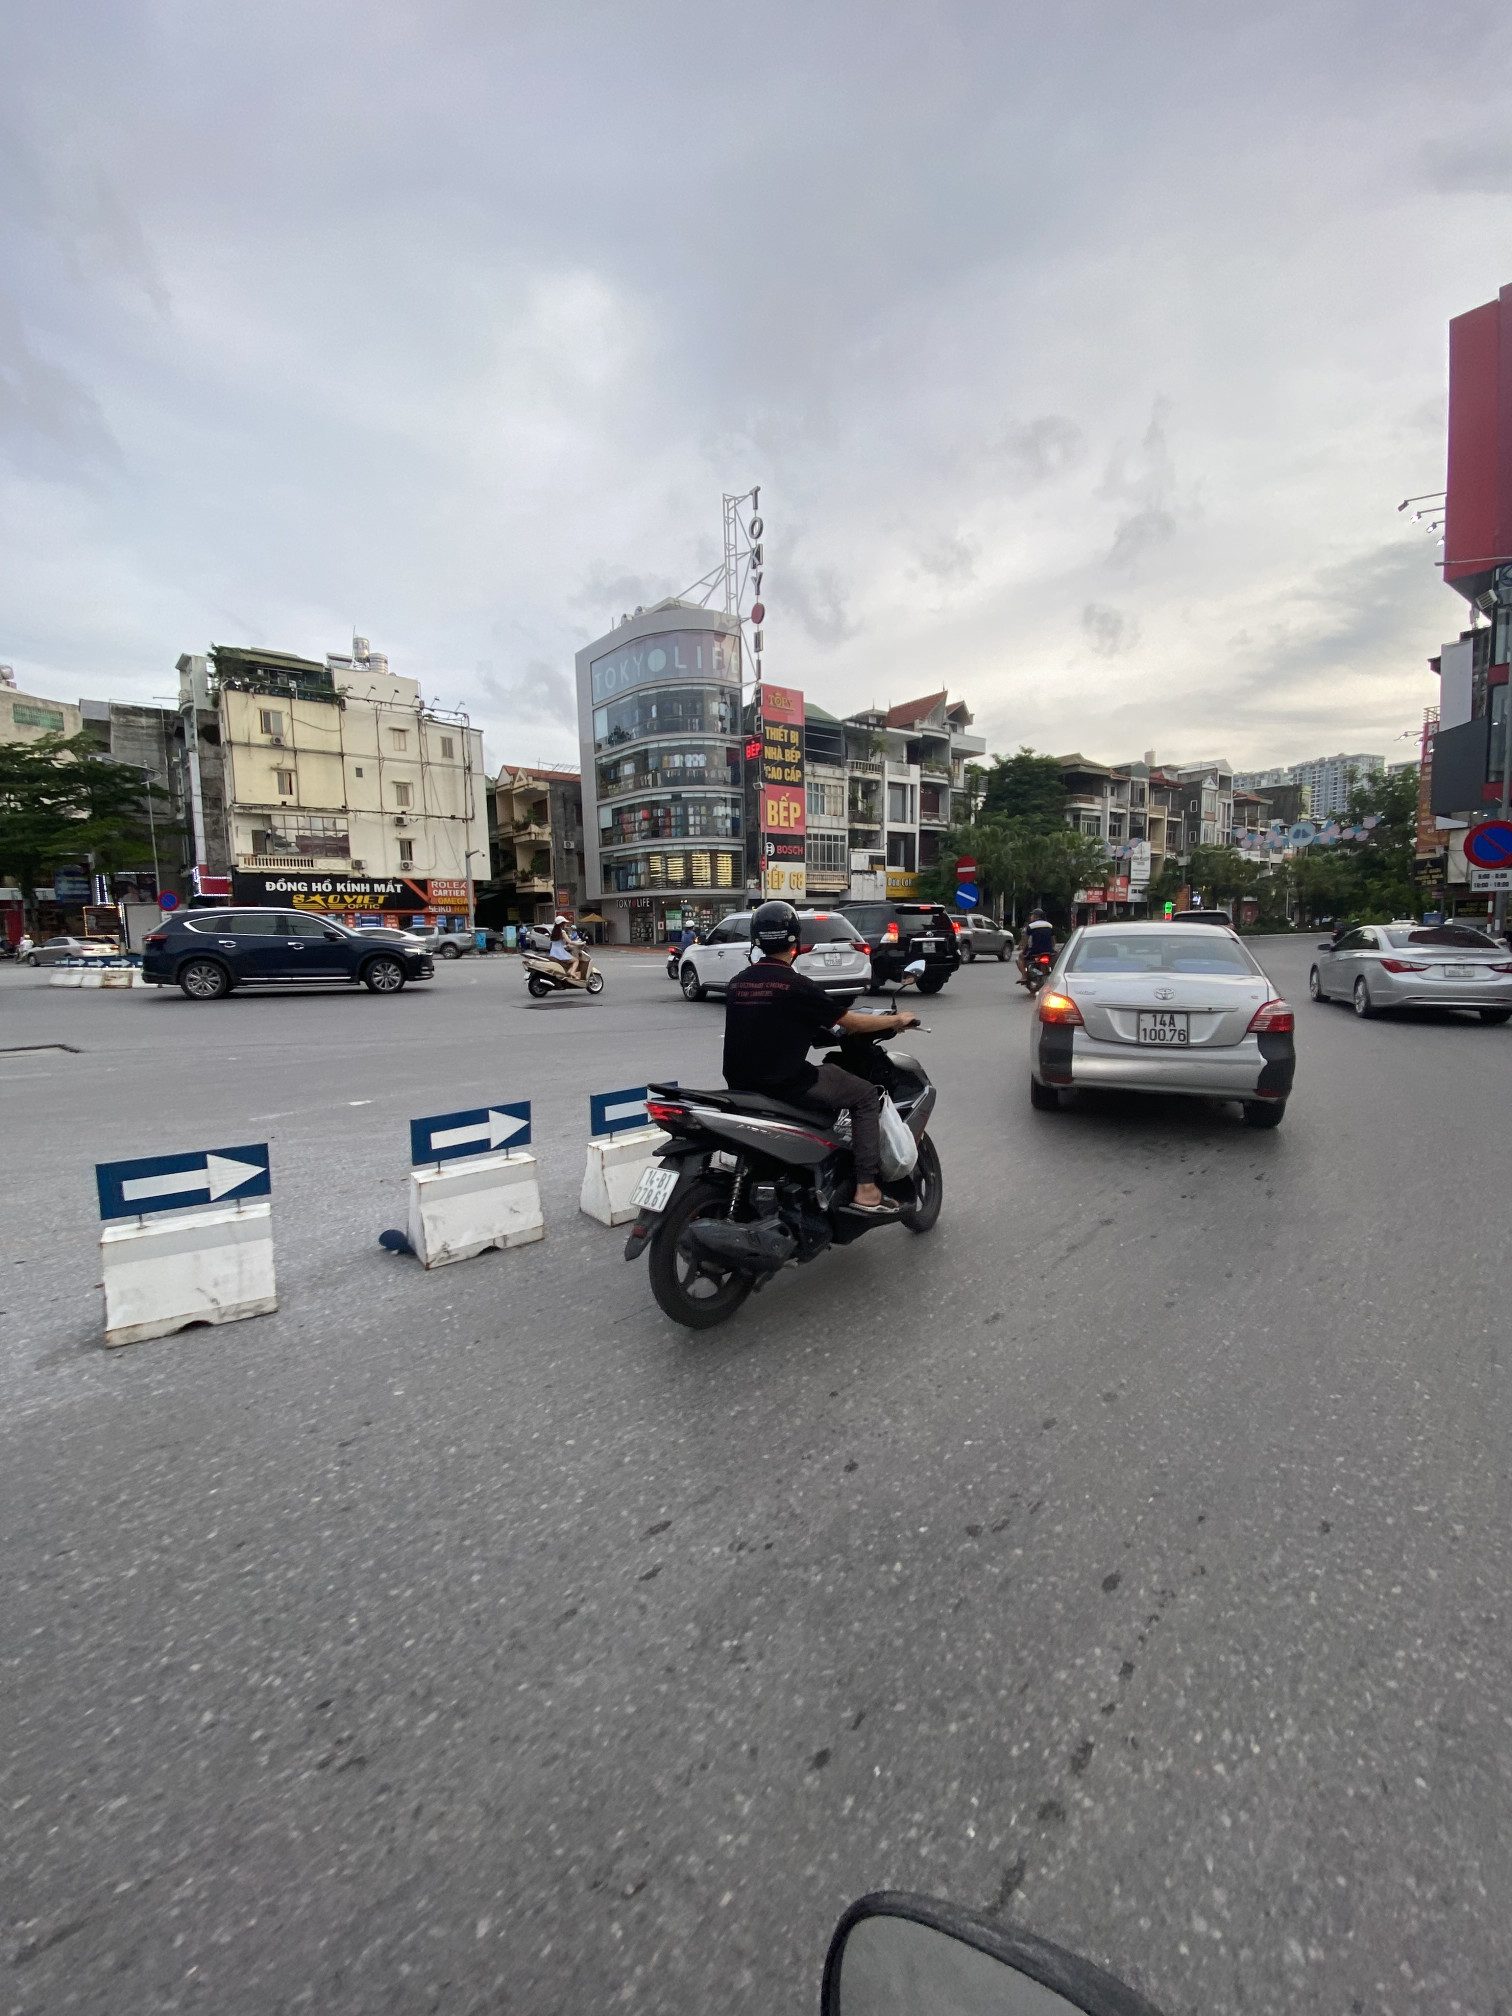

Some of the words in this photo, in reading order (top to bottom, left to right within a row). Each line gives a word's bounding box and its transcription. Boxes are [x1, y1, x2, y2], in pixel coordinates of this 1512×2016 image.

[785, 746, 801, 763] BẾP
[764, 764, 783, 780] CAO
[766, 793, 801, 828] BẾP
[776, 845, 804, 855] BOSCH
[265, 878, 308, 892] ĐỒNG
[312, 878, 333, 893] HỒ
[336, 880, 371, 893] KÍNH
[373, 880, 403, 893] MẮT
[431, 881, 467, 889] ROLEX
[432, 889, 466, 897] CARTIER
[428, 905, 452, 913] SEIKO
[1152, 1014, 1176, 1028] 14A
[1142, 1028, 1187, 1042] 100.76
